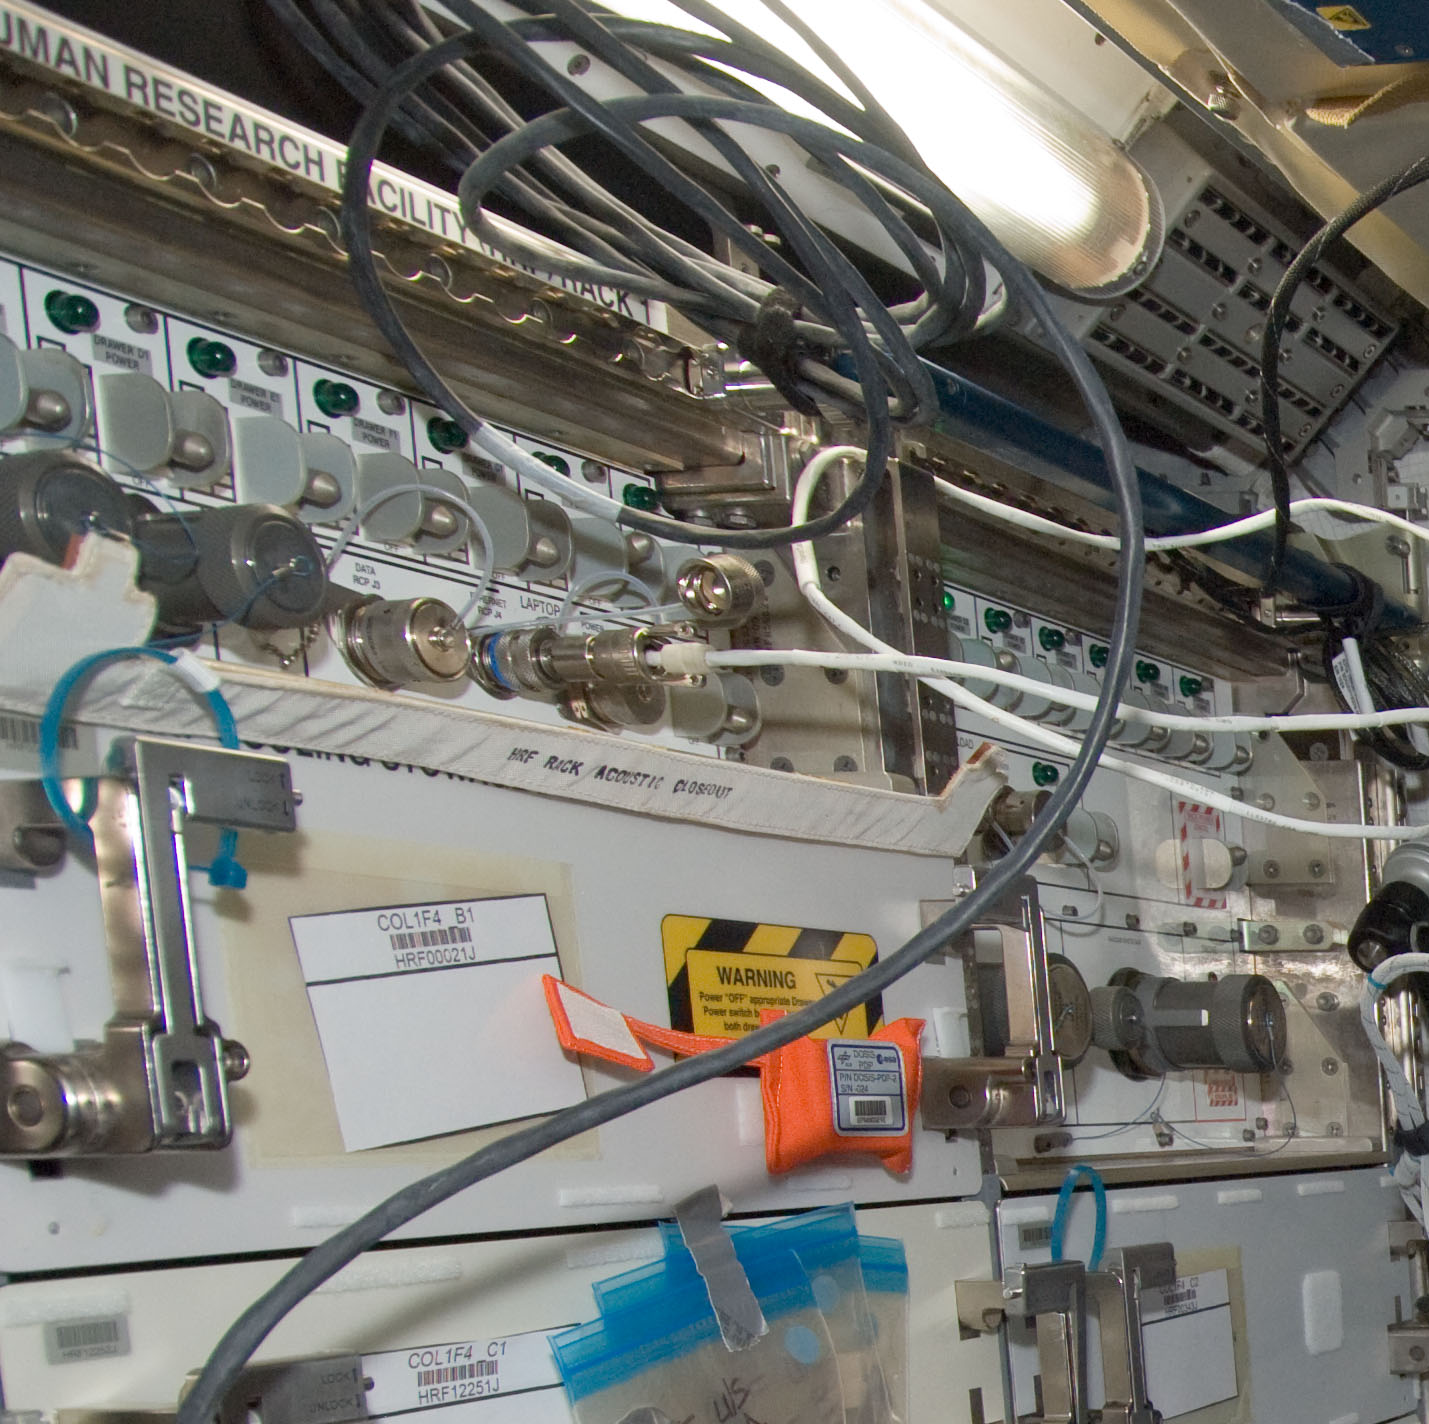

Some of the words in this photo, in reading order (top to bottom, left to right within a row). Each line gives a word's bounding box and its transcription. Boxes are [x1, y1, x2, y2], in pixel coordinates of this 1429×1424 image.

[123, 63, 326, 183] RESEARCH
[94, 335, 135, 355] DRAWER
[105, 352, 140, 370] POWER
[240, 395, 272, 412] POWER
[362, 433, 391, 450] POWER
[355, 561, 376, 577] DATA
[519, 591, 561, 617] LAPTOP
[507, 747, 540, 764] HRF
[543, 755, 584, 777] RACK
[594, 764, 664, 791] ACOUSTIC
[672, 778, 734, 799] CLOSEOUT
[394, 946, 476, 969] HRF00021J
[716, 965, 796, 989] WARNING
[699, 991, 723, 1003] Power
[703, 1007, 728, 1018] Power
[729, 1009, 753, 1019] switch
[723, 1020, 741, 1032] both
[417, 1377, 500, 1406] HRF12251J
